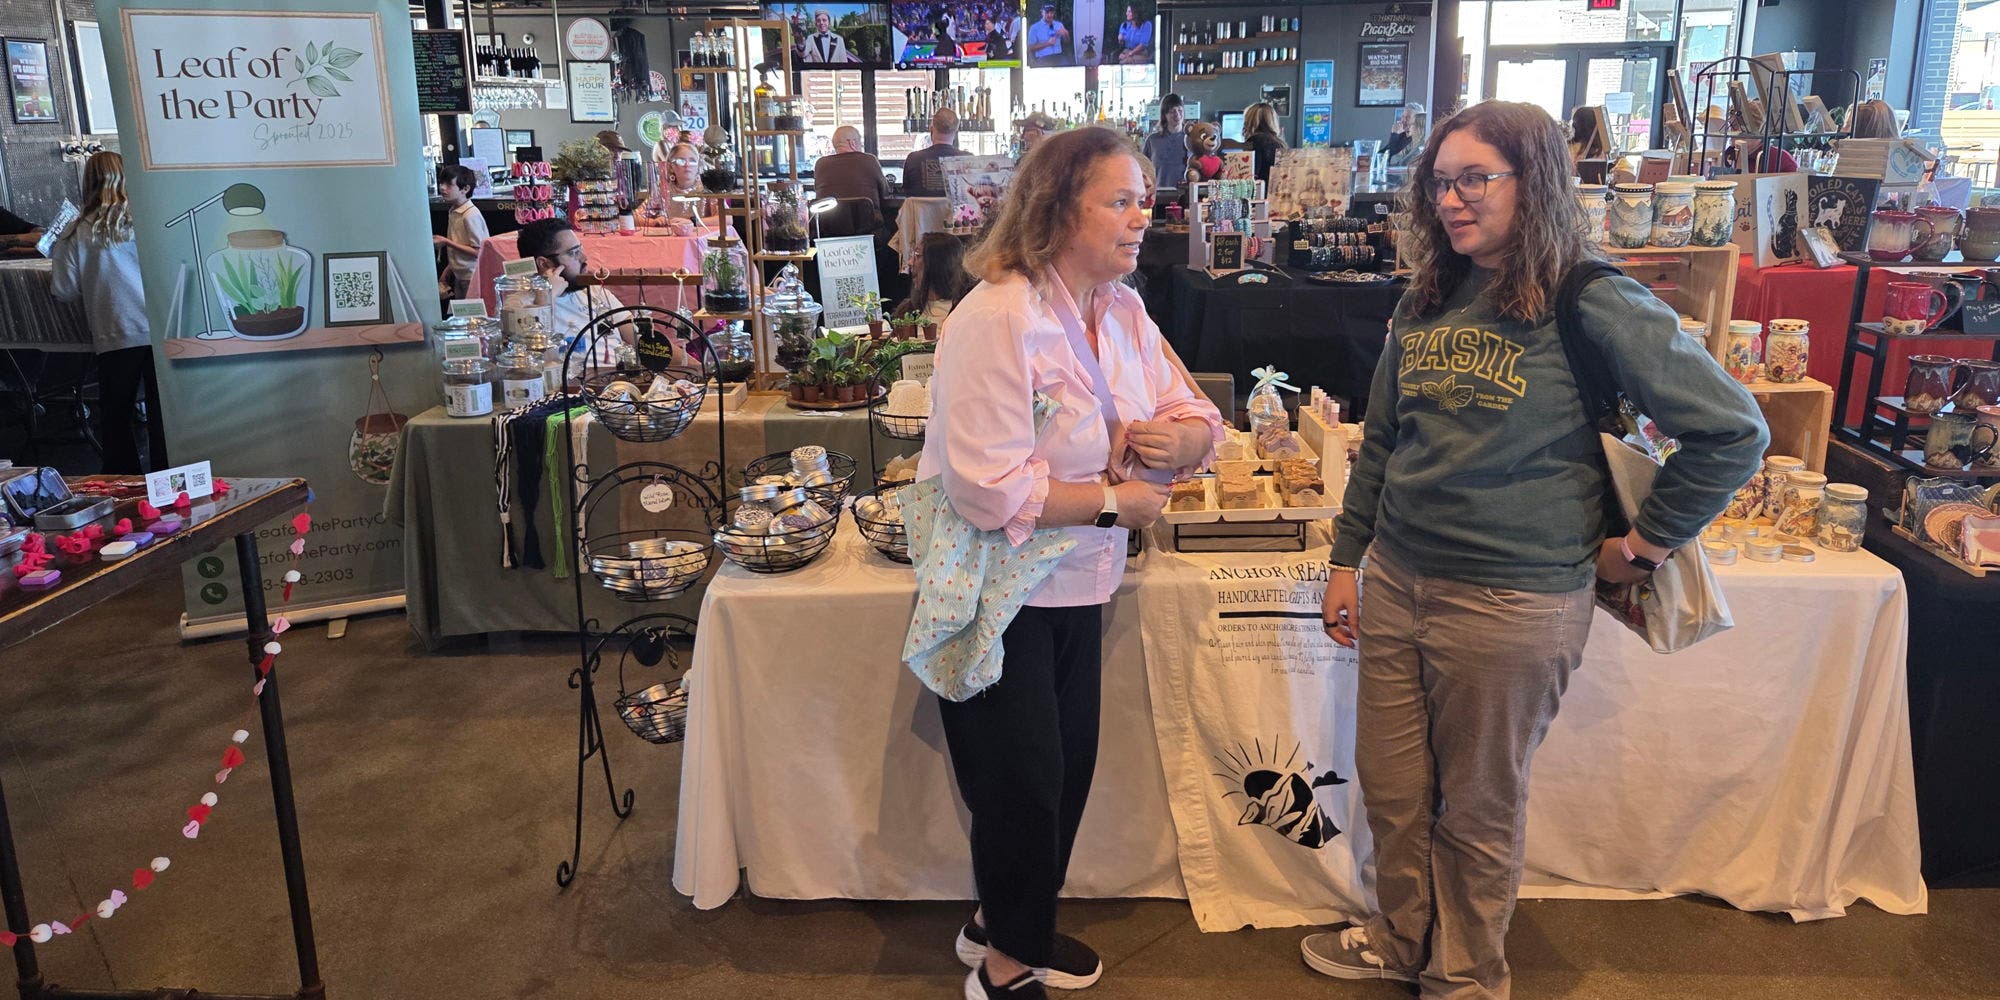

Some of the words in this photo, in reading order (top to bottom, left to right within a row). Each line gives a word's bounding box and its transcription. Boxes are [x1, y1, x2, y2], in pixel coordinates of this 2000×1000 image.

[152, 46, 247, 79] Leaf
[247, 46, 291, 79] of
[159, 88, 219, 120] the
[224, 90, 323, 125] Party
[253, 122, 310, 150] Sprouted
[317, 122, 353, 140] 2025
[1809, 178, 1842, 198] OILED
[1841, 214, 1866, 225] HERE
[823, 246, 843, 257] Leaf
[843, 246, 855, 256] of
[824, 259, 838, 268] the
[838, 257, 859, 267] Party
[1399, 326, 1527, 398] BASIL
[1209, 565, 1287, 581] ANCHOR
[1288, 561, 1328, 582] CREA
[1289, 591, 1310, 605] GIFTS
[1312, 592, 1324, 605] AN
[1217, 624, 1246, 633] ORDERS
[1247, 624, 1258, 632] TO
